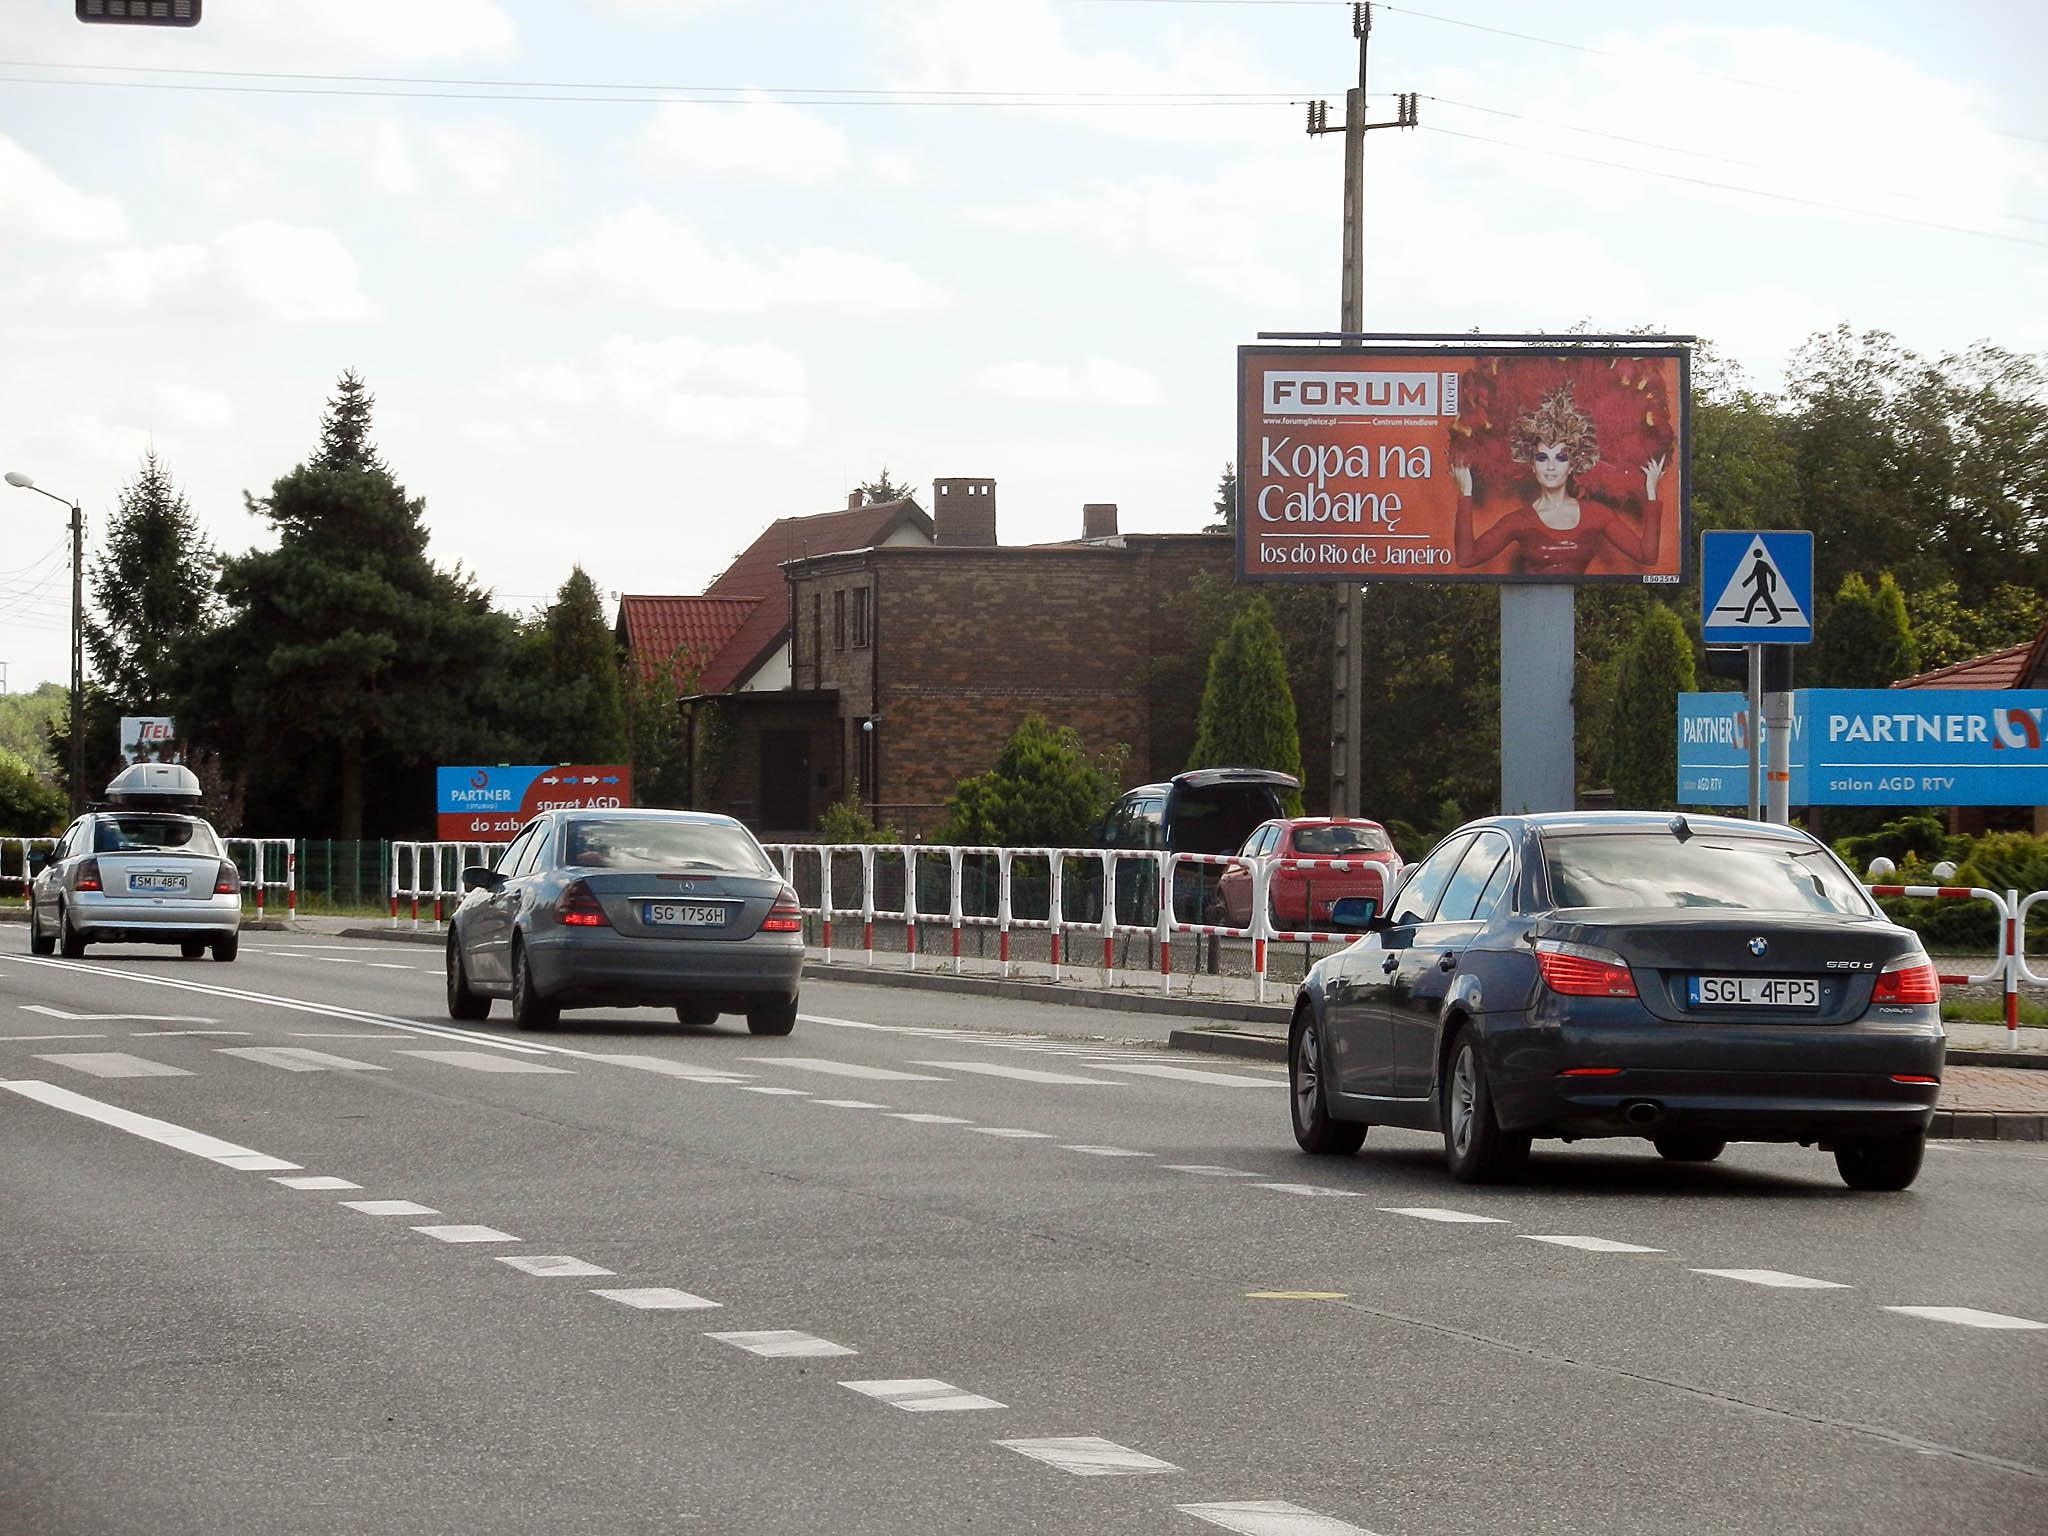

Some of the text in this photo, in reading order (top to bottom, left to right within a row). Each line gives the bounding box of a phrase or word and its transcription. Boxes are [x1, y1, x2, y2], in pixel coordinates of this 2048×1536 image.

[1272, 380, 1427, 406] FORUM
[1444, 374, 1456, 414] loteria
[1262, 416, 1337, 427] www.forumgliwice.pl
[1372, 418, 1403, 427] Centrum
[1261, 436, 1431, 489] Kopa na
[1257, 482, 1402, 532] Cabanę
[1260, 542, 1452, 565] los do Rio de Janeiro
[1683, 716, 1733, 744] PARTNER
[1829, 714, 1989, 743] PARTNER
[1829, 777, 1955, 791] salon AGD RTV
[451, 789, 512, 801] PARTNER
[586, 796, 620, 809] AGD
[470, 817, 490, 832] do
[137, 876, 185, 887] SMI 48F4
[653, 906, 724, 922] SG 1756H
[1826, 961, 1874, 969] 520 d
[1703, 979, 1816, 1004] SGL 4FP5
